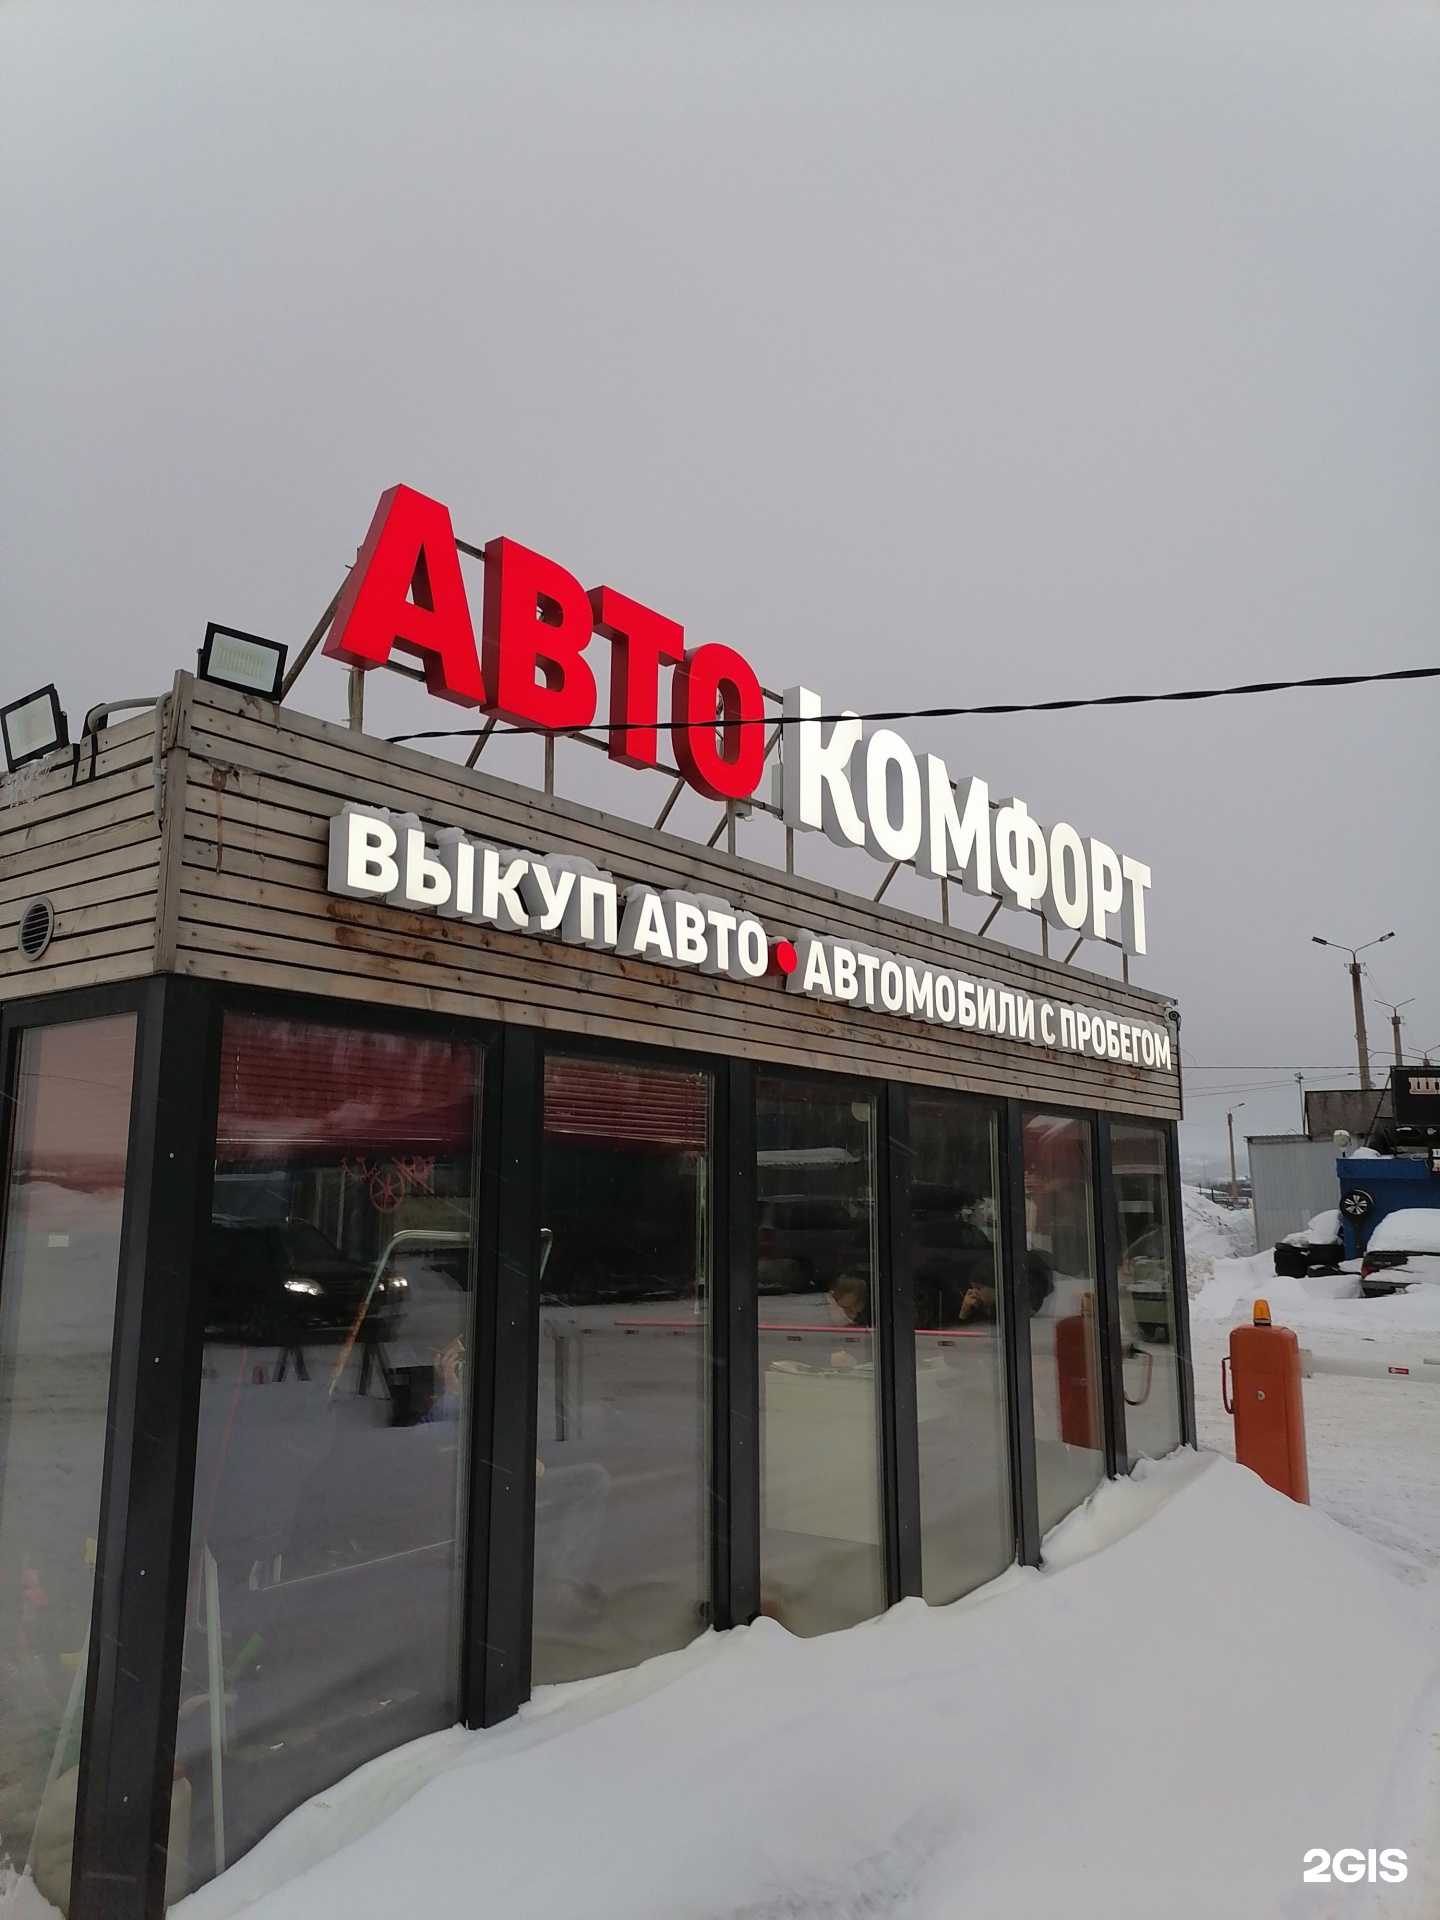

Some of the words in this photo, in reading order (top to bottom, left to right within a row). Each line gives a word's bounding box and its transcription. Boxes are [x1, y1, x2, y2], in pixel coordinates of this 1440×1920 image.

[324, 484, 765, 800] АВТО
[796, 686, 1152, 956] КОМФОРТ
[345, 811, 618, 946] ВЫКУП
[633, 893, 769, 977] АВТО
[803, 940, 1035, 1041] АВТОМОБИЛИ
[1040, 1003, 1056, 1045] С
[1060, 1007, 1172, 1071] ПРОБЕГОМ
